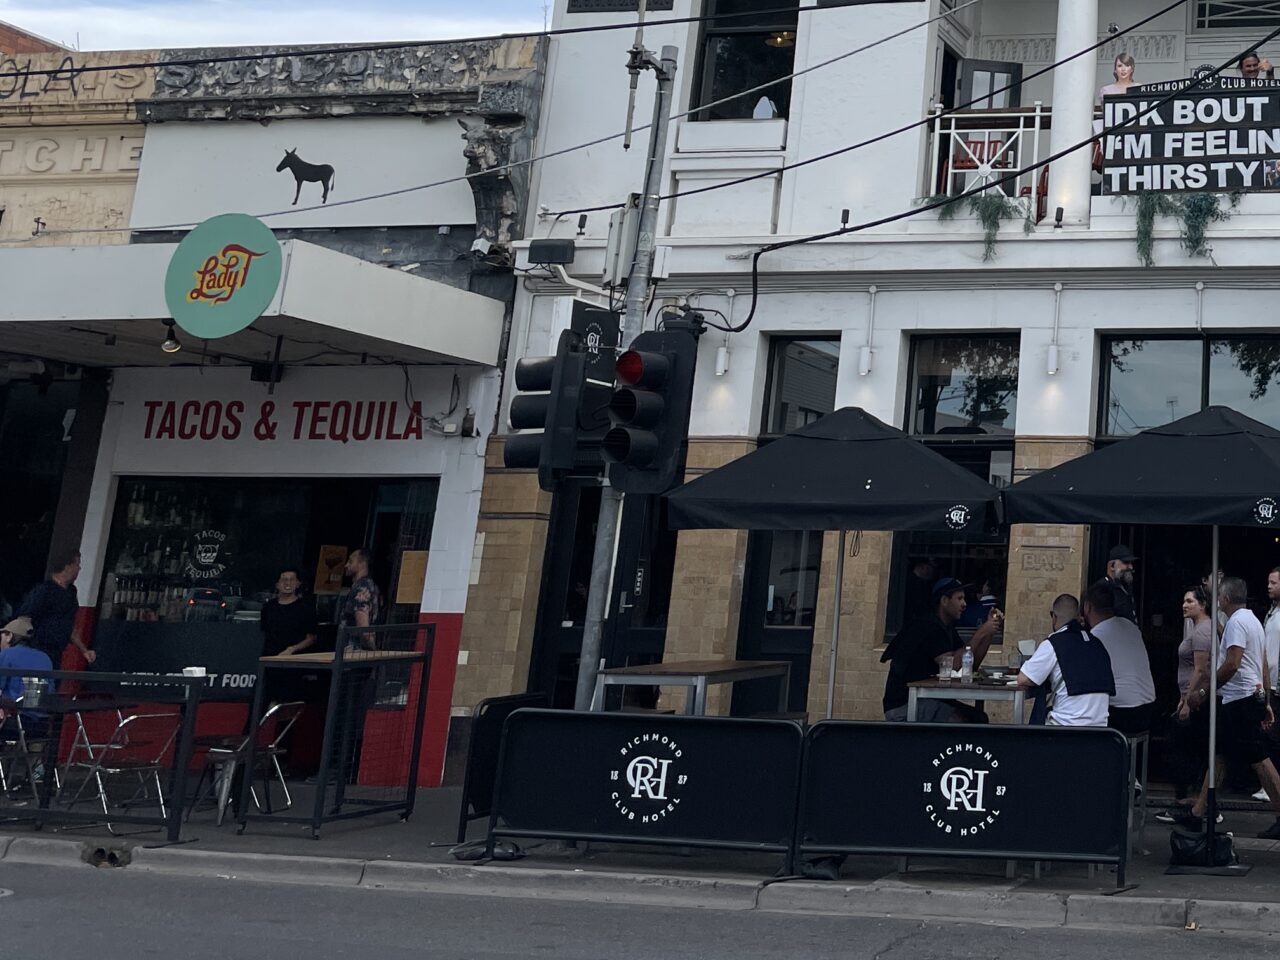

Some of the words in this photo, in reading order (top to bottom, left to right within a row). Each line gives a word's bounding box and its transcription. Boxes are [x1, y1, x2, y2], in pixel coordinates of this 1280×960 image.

[1220, 78, 1246, 89] CLUB
[1105, 101, 1164, 128] IDK
[1173, 97, 1269, 124] BOUT
[1105, 134, 1151, 159] I'M
[1104, 161, 1260, 192] THIRSTY
[144, 400, 244, 440] TACOS
[253, 400, 278, 441] &
[292, 400, 423, 444] TEQUILA
[194, 530, 226, 541] TACOS
[184, 562, 226, 579] TEQUILA
[1022, 553, 1066, 572] BAR
[620, 733, 682, 756] RICHMOND
[932, 743, 999, 768] RICHMOND
[610, 770, 619, 780] 18
[677, 774, 688, 785] 87
[923, 782, 932, 793] 18
[996, 785, 1006, 796] 87
[611, 792, 635, 820] CLUB
[642, 798, 681, 823] HOTEL
[925, 804, 952, 833] CLUB
[960, 810, 1000, 836] HOTEL
